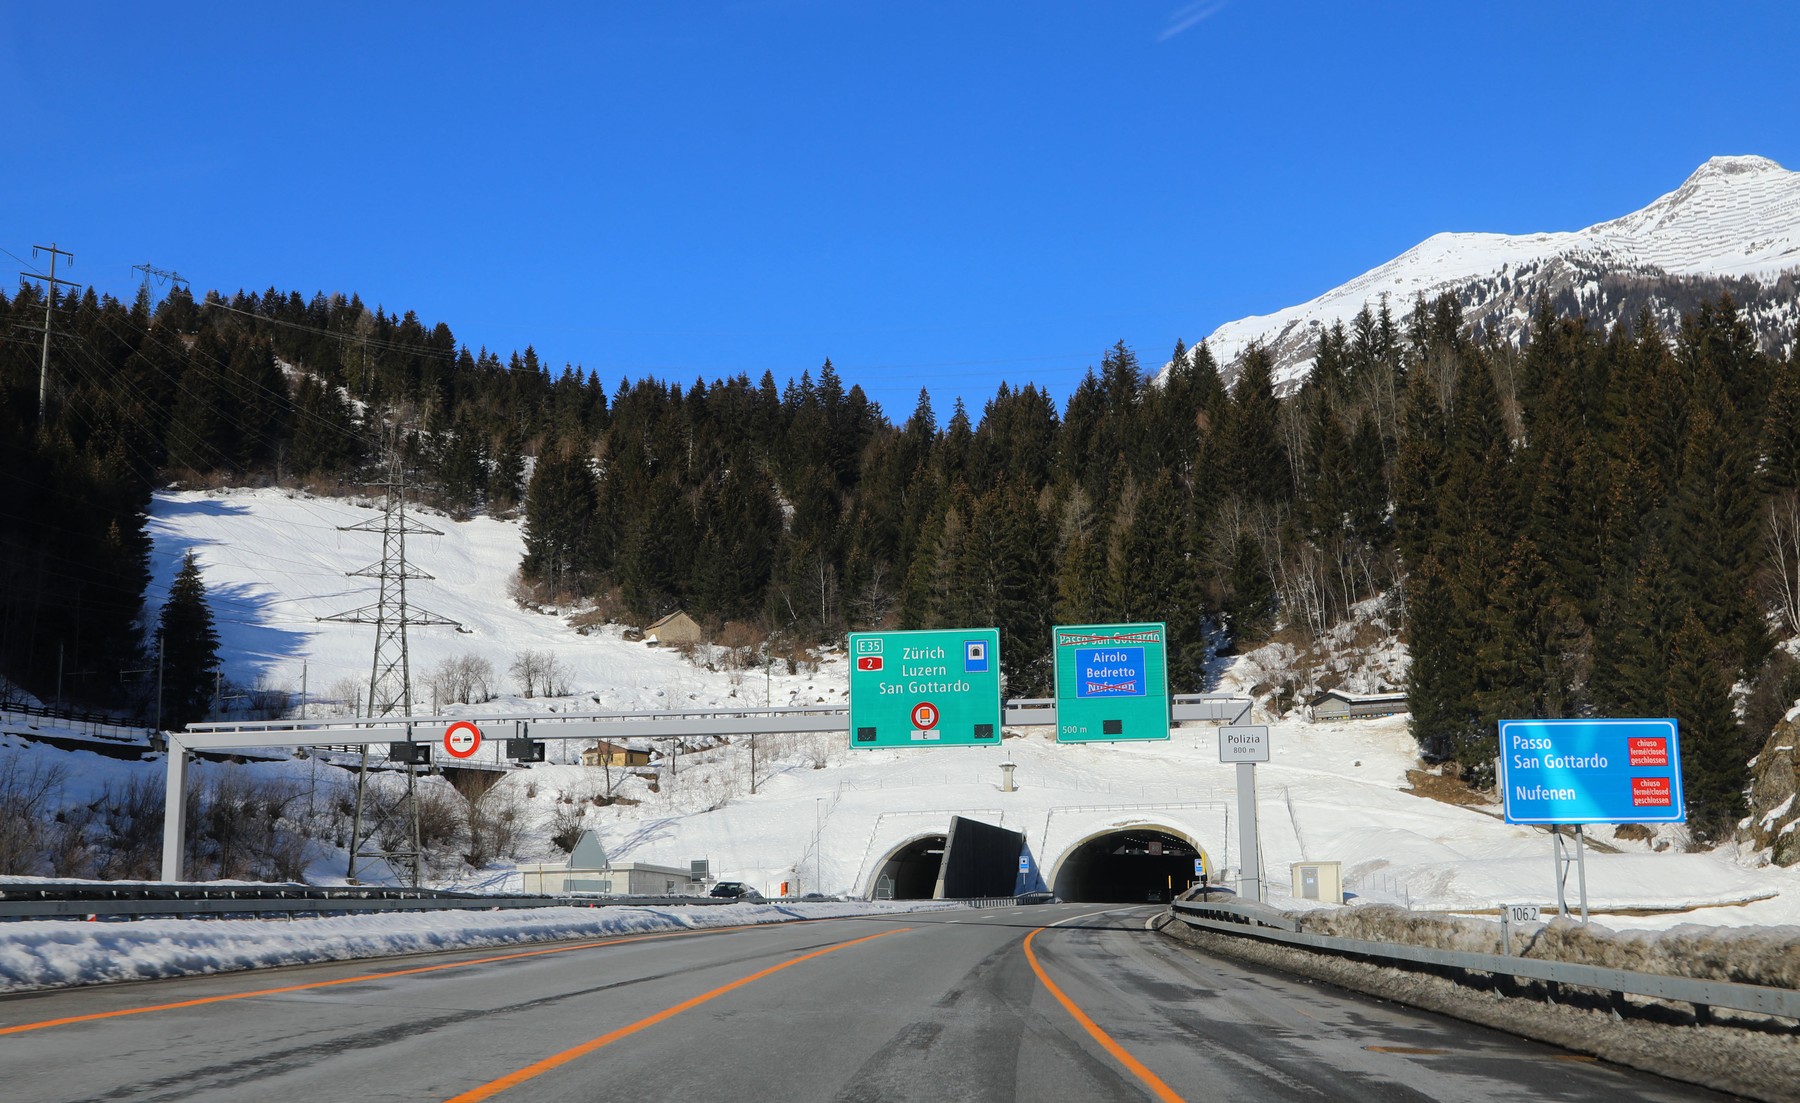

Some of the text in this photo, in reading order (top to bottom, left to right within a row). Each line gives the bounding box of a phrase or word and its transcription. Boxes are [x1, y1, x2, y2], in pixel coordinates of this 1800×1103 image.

[1060, 631, 1160, 646] Passo San Gottardo
[903, 646, 945, 660] Zürich
[1093, 652, 1128, 663] Airolo
[867, 660, 873, 669] 2
[902, 665, 947, 677] Luzern
[1086, 667, 1135, 678] Bedretto
[879, 680, 970, 695] San Gottardo
[922, 731, 928, 739] E
[1062, 726, 1078, 734] 500
[1228, 734, 1260, 744] Polizia
[1513, 735, 1552, 750] Passo
[1637, 739, 1657, 747] chiuso
[1233, 746, 1247, 754] 800
[1514, 753, 1608, 769] San Gottardo
[1630, 756, 1666, 766] geschlossen
[1640, 779, 1661, 787] chiuso
[1516, 785, 1576, 801] Nufenen
[1634, 797, 1669, 806] geschlossen
[1512, 907, 1537, 921] 106.2
